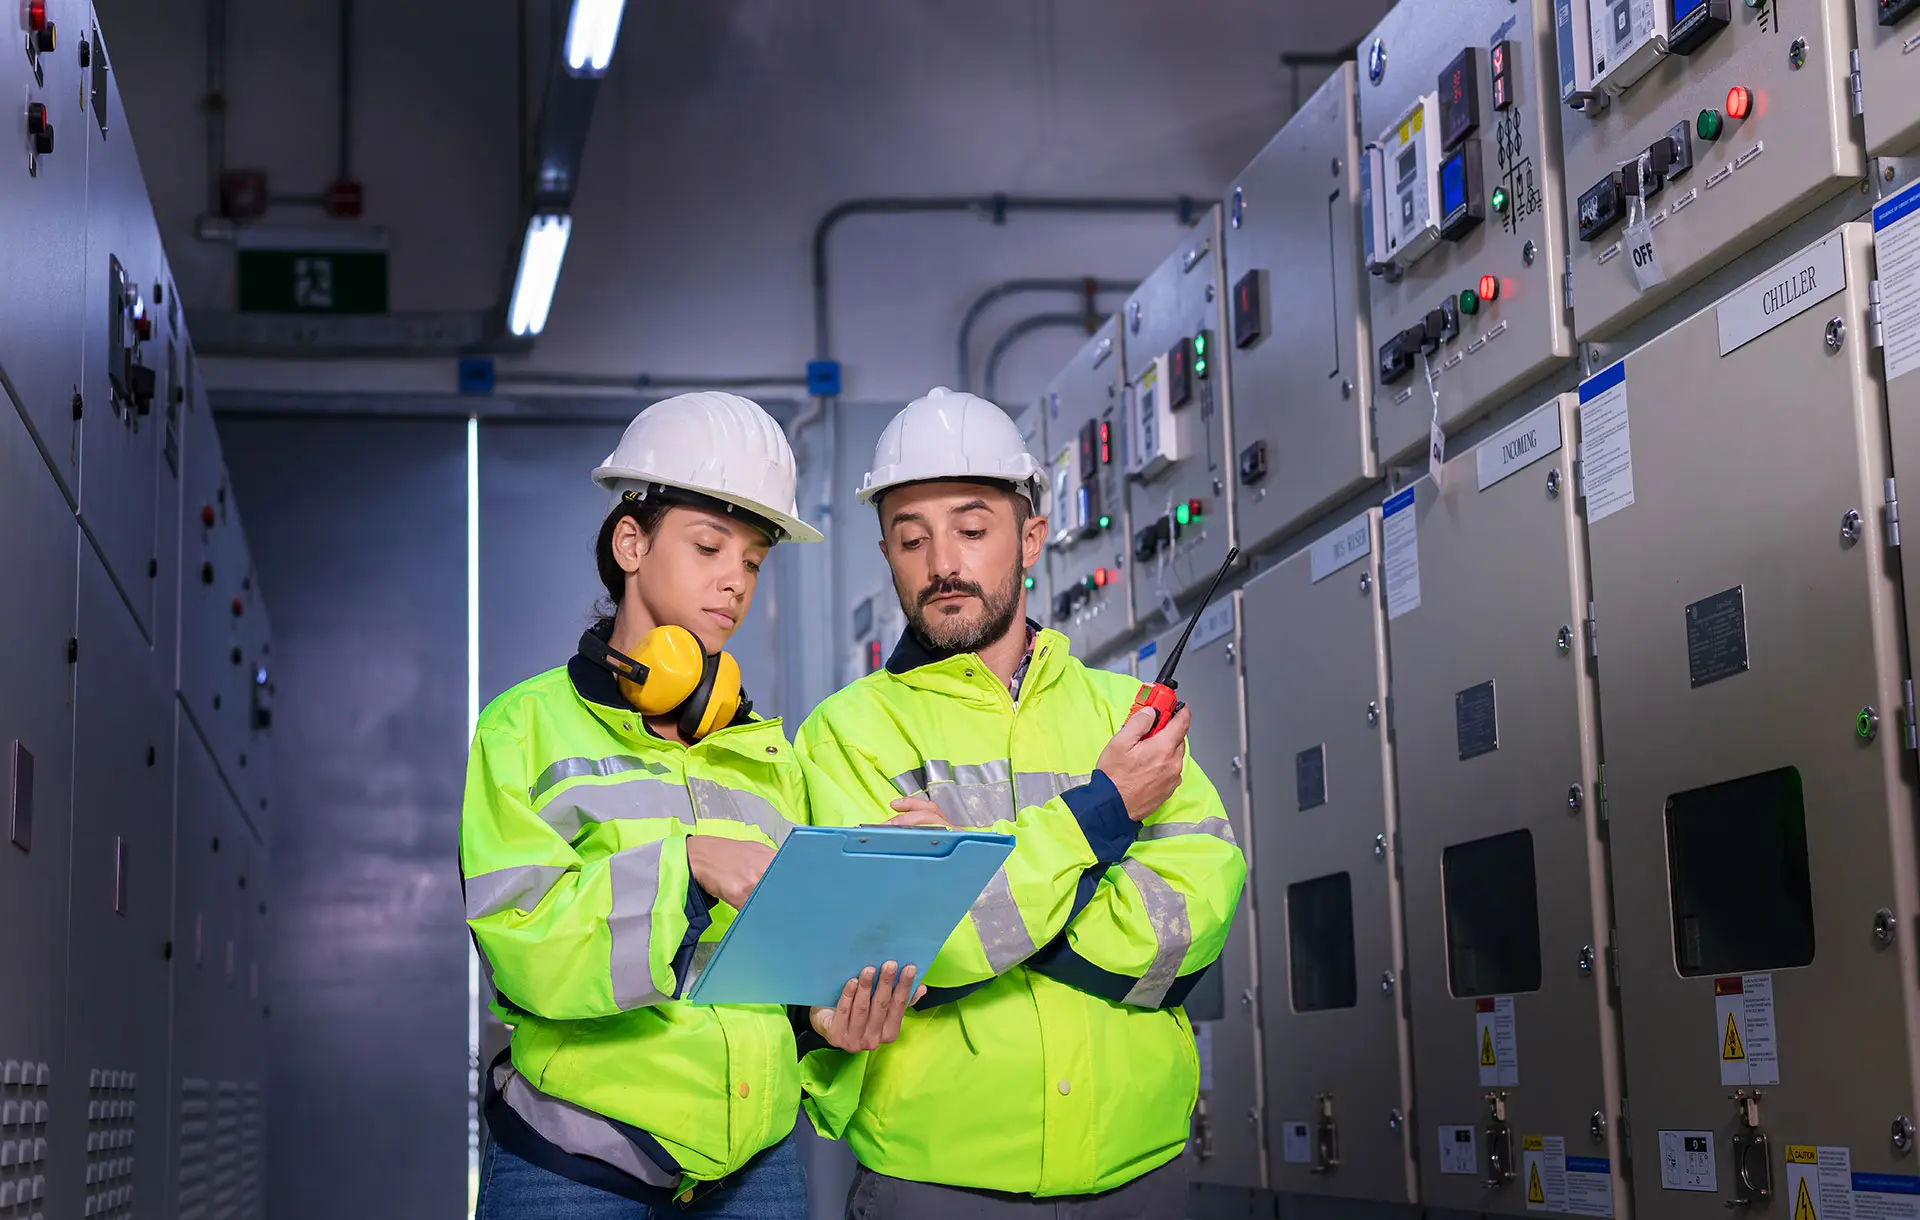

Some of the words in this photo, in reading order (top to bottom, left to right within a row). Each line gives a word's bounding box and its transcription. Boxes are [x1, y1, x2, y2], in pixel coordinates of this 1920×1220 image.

[1632, 242, 1653, 267] OFF
[1762, 265, 1817, 315] CHILLER
[1501, 429, 1537, 464] INCOMING
[1794, 1150, 1815, 1160] CAUTION
